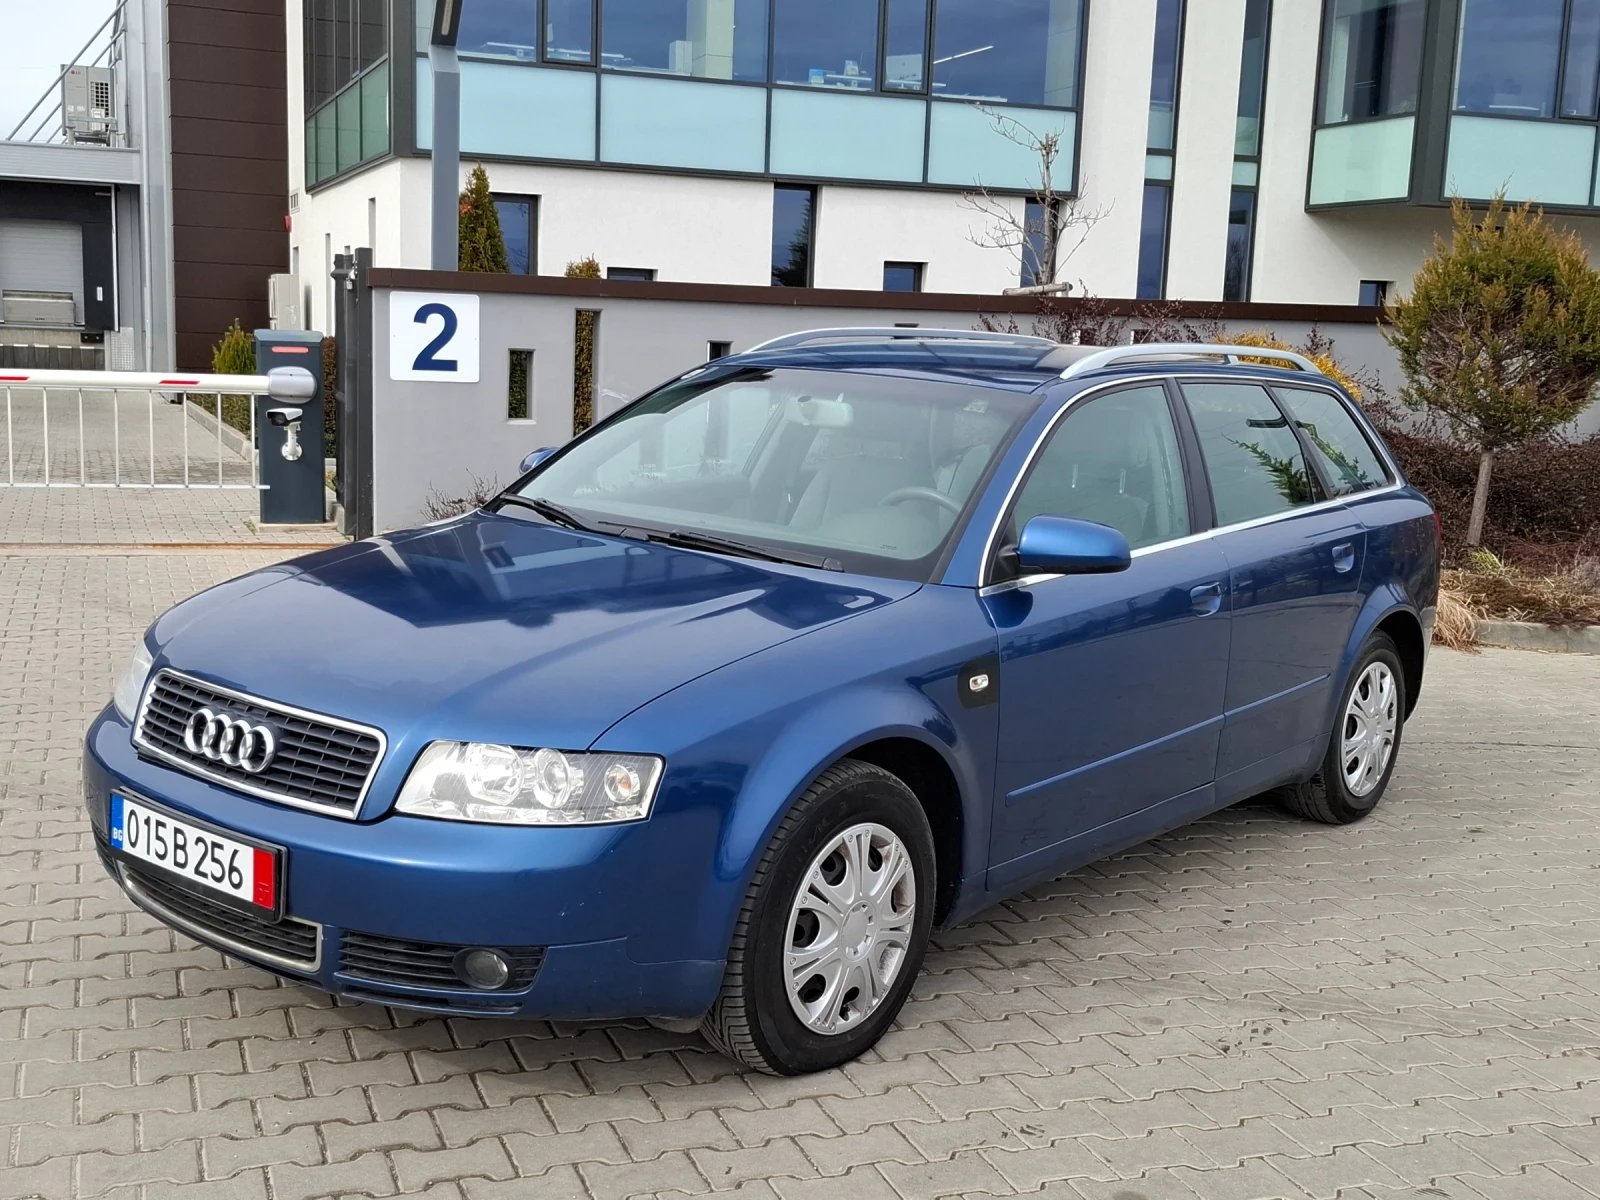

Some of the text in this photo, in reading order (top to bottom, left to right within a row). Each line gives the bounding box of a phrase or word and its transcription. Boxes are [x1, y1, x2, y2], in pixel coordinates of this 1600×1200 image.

[412, 303, 458, 372] 2
[113, 827, 123, 841] BG
[127, 809, 244, 890] 015B256
